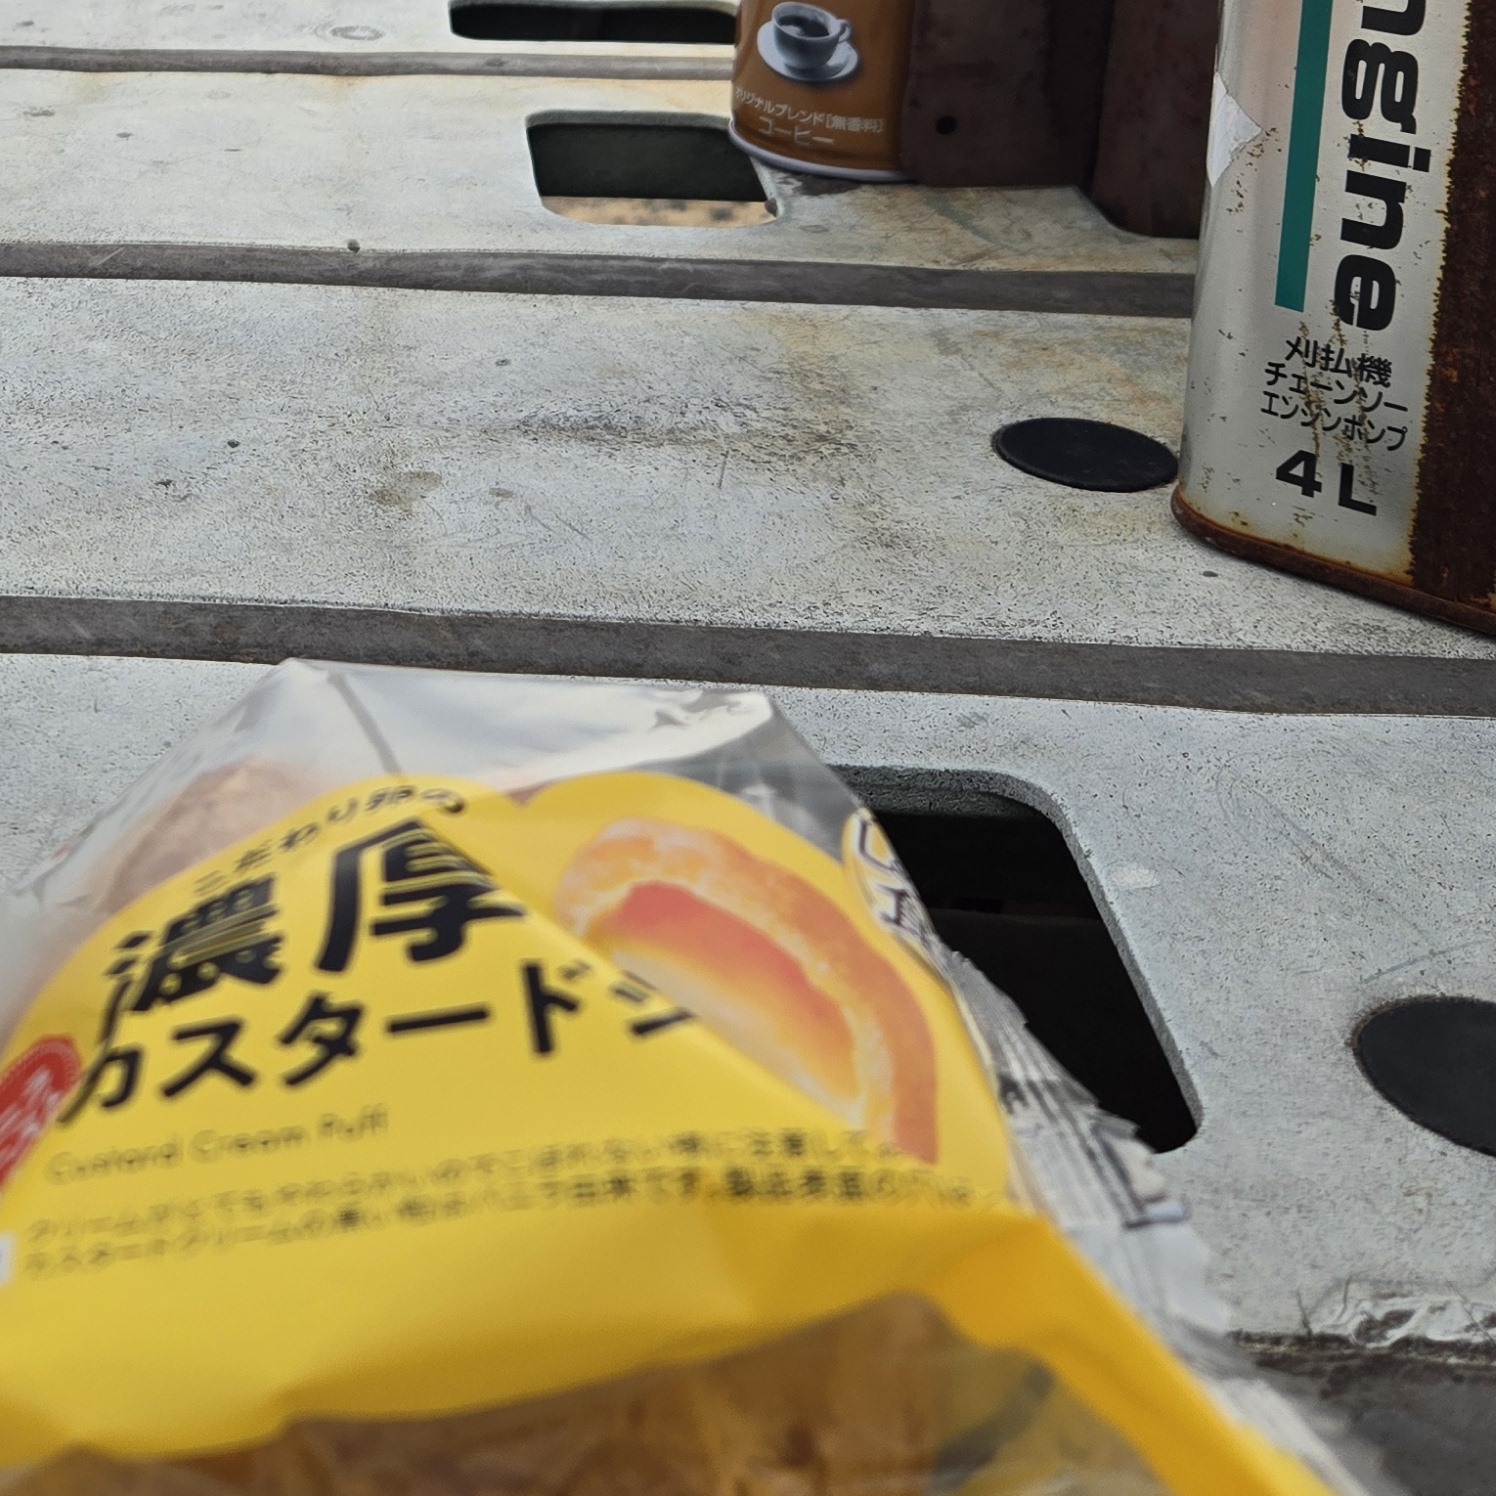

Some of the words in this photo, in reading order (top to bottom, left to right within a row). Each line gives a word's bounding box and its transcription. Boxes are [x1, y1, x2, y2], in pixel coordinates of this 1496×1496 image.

[757, 115, 835, 147] コーヒー
[1264, 361, 1408, 413] チェーンソー
[1284, 336, 1392, 388] 刈払機
[100, 815, 528, 1044] 濃厚
